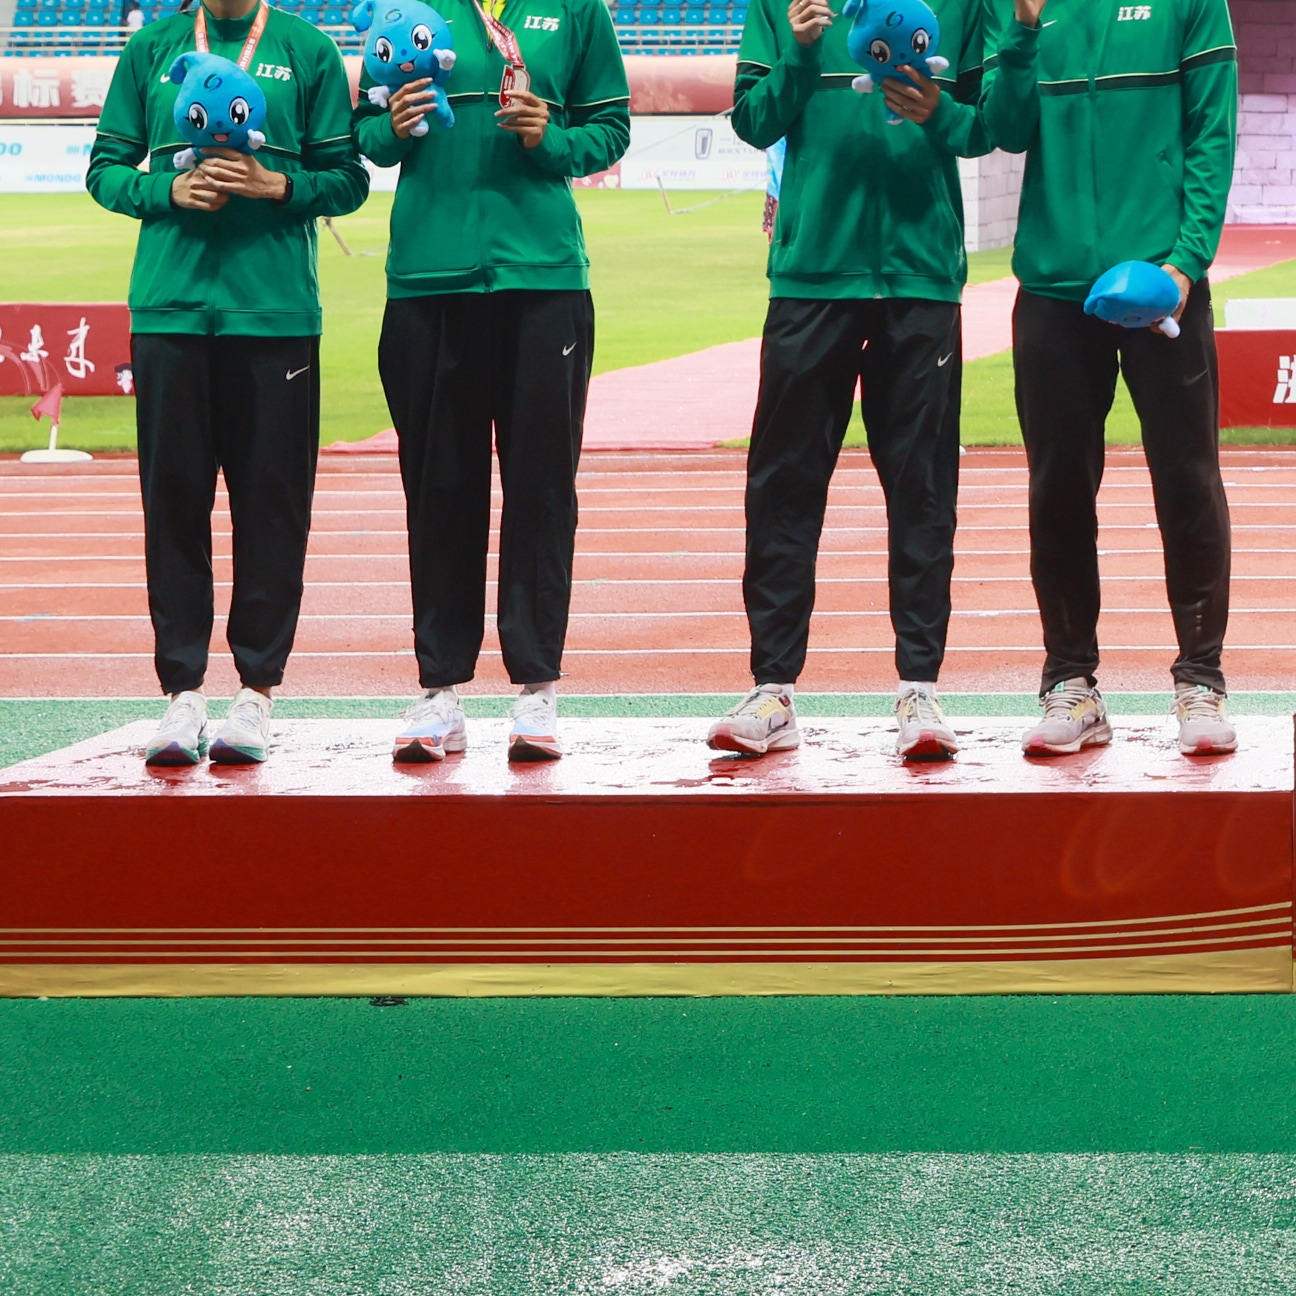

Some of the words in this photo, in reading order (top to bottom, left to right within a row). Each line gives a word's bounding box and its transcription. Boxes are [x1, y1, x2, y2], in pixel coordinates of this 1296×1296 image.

[1117, 5, 1152, 21] 江苏
[524, 15, 560, 32] 江苏
[256, 63, 293, 82] 江苏
[0, 68, 106, 109] 标赛
